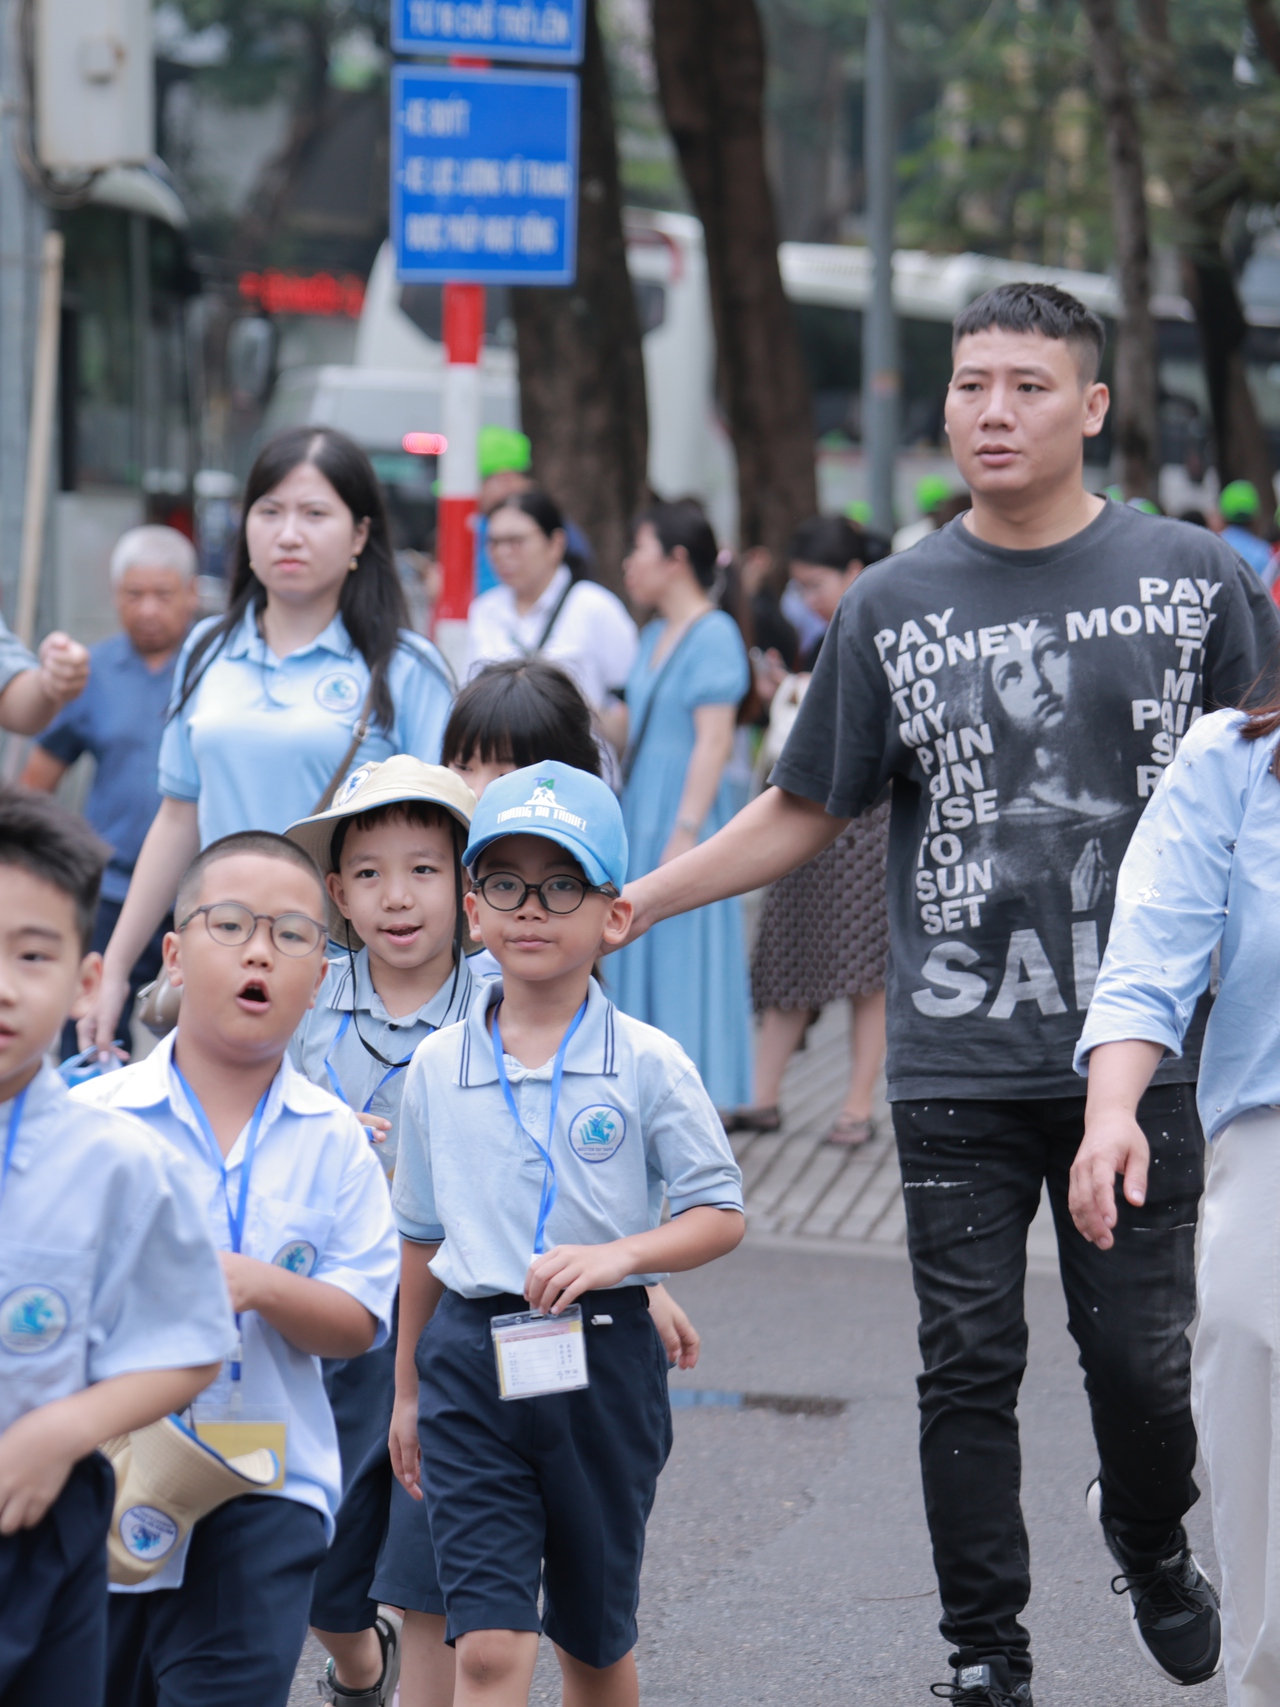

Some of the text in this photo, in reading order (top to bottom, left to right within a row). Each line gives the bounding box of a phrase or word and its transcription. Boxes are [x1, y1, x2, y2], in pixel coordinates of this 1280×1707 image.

[1139, 577, 1222, 609] PAY
[873, 607, 955, 662] PAY
[882, 619, 1039, 692] MONEY
[891, 678, 936, 720] TO
[898, 701, 946, 748] MY
[916, 859, 993, 902] SUN
[921, 894, 987, 935] SET
